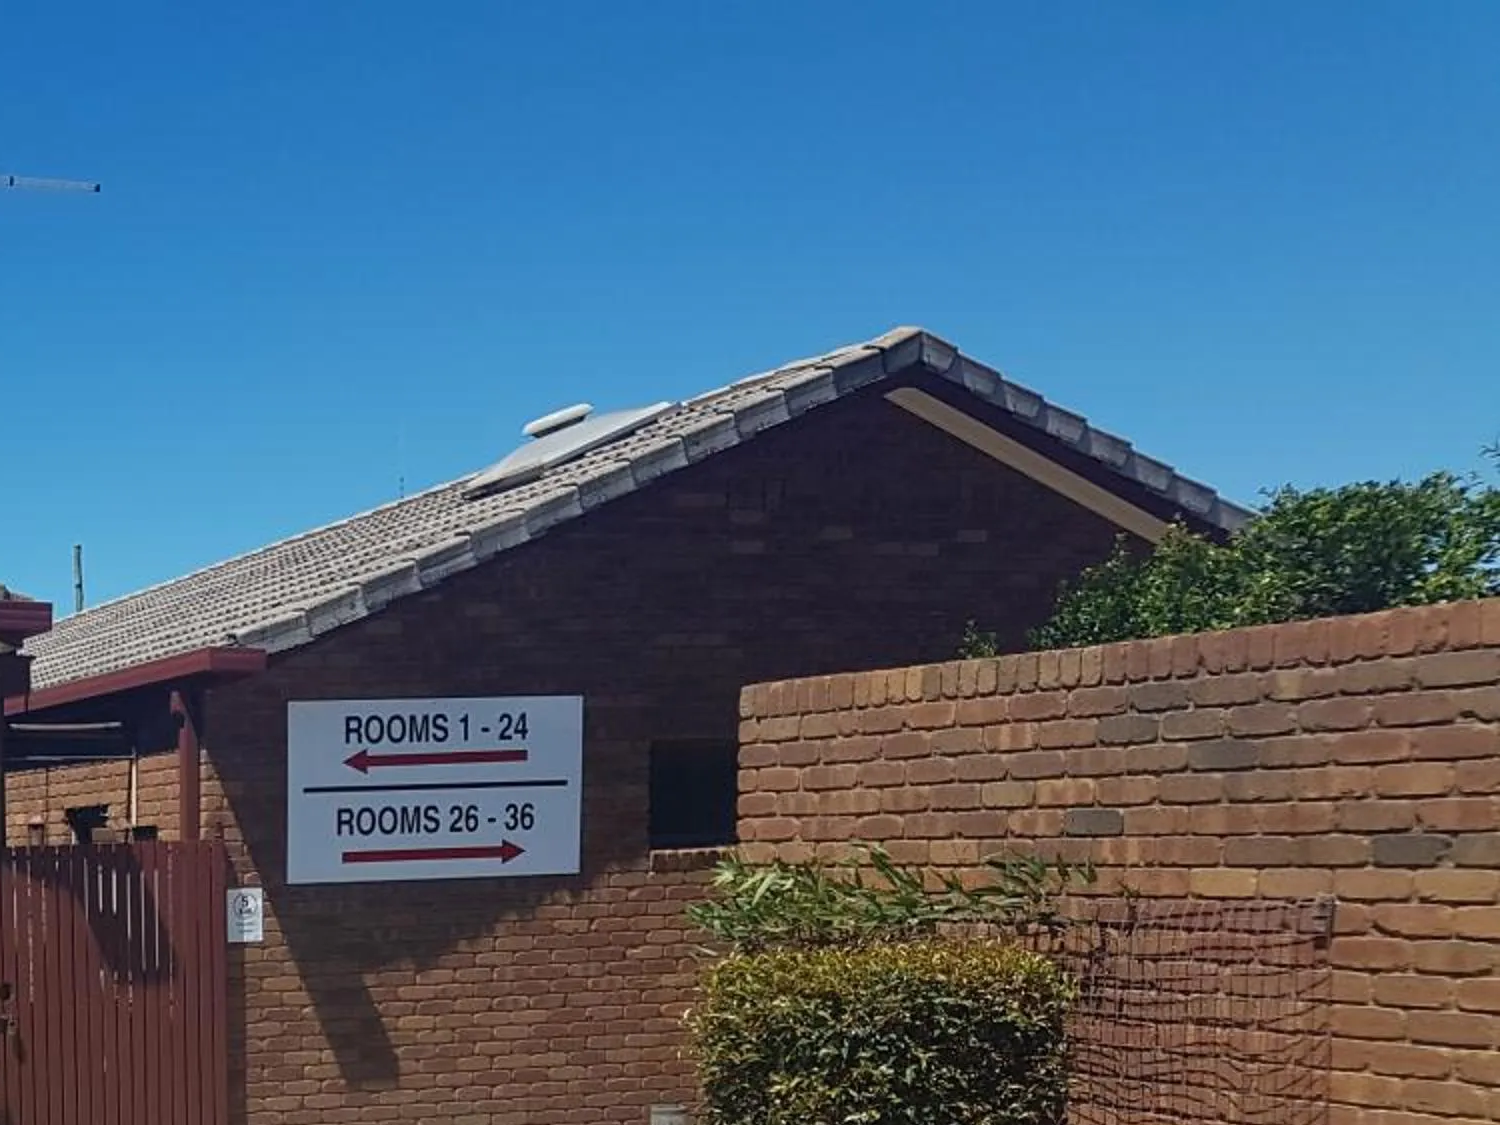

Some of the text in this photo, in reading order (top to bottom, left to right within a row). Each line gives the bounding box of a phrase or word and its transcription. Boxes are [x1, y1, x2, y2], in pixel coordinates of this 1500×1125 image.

[344, 713, 450, 744] ROOMS
[458, 712, 470, 741] 1
[498, 711, 529, 741] 24
[335, 804, 441, 836] ROOMS
[448, 804, 479, 833] 26
[504, 802, 535, 831] 36
